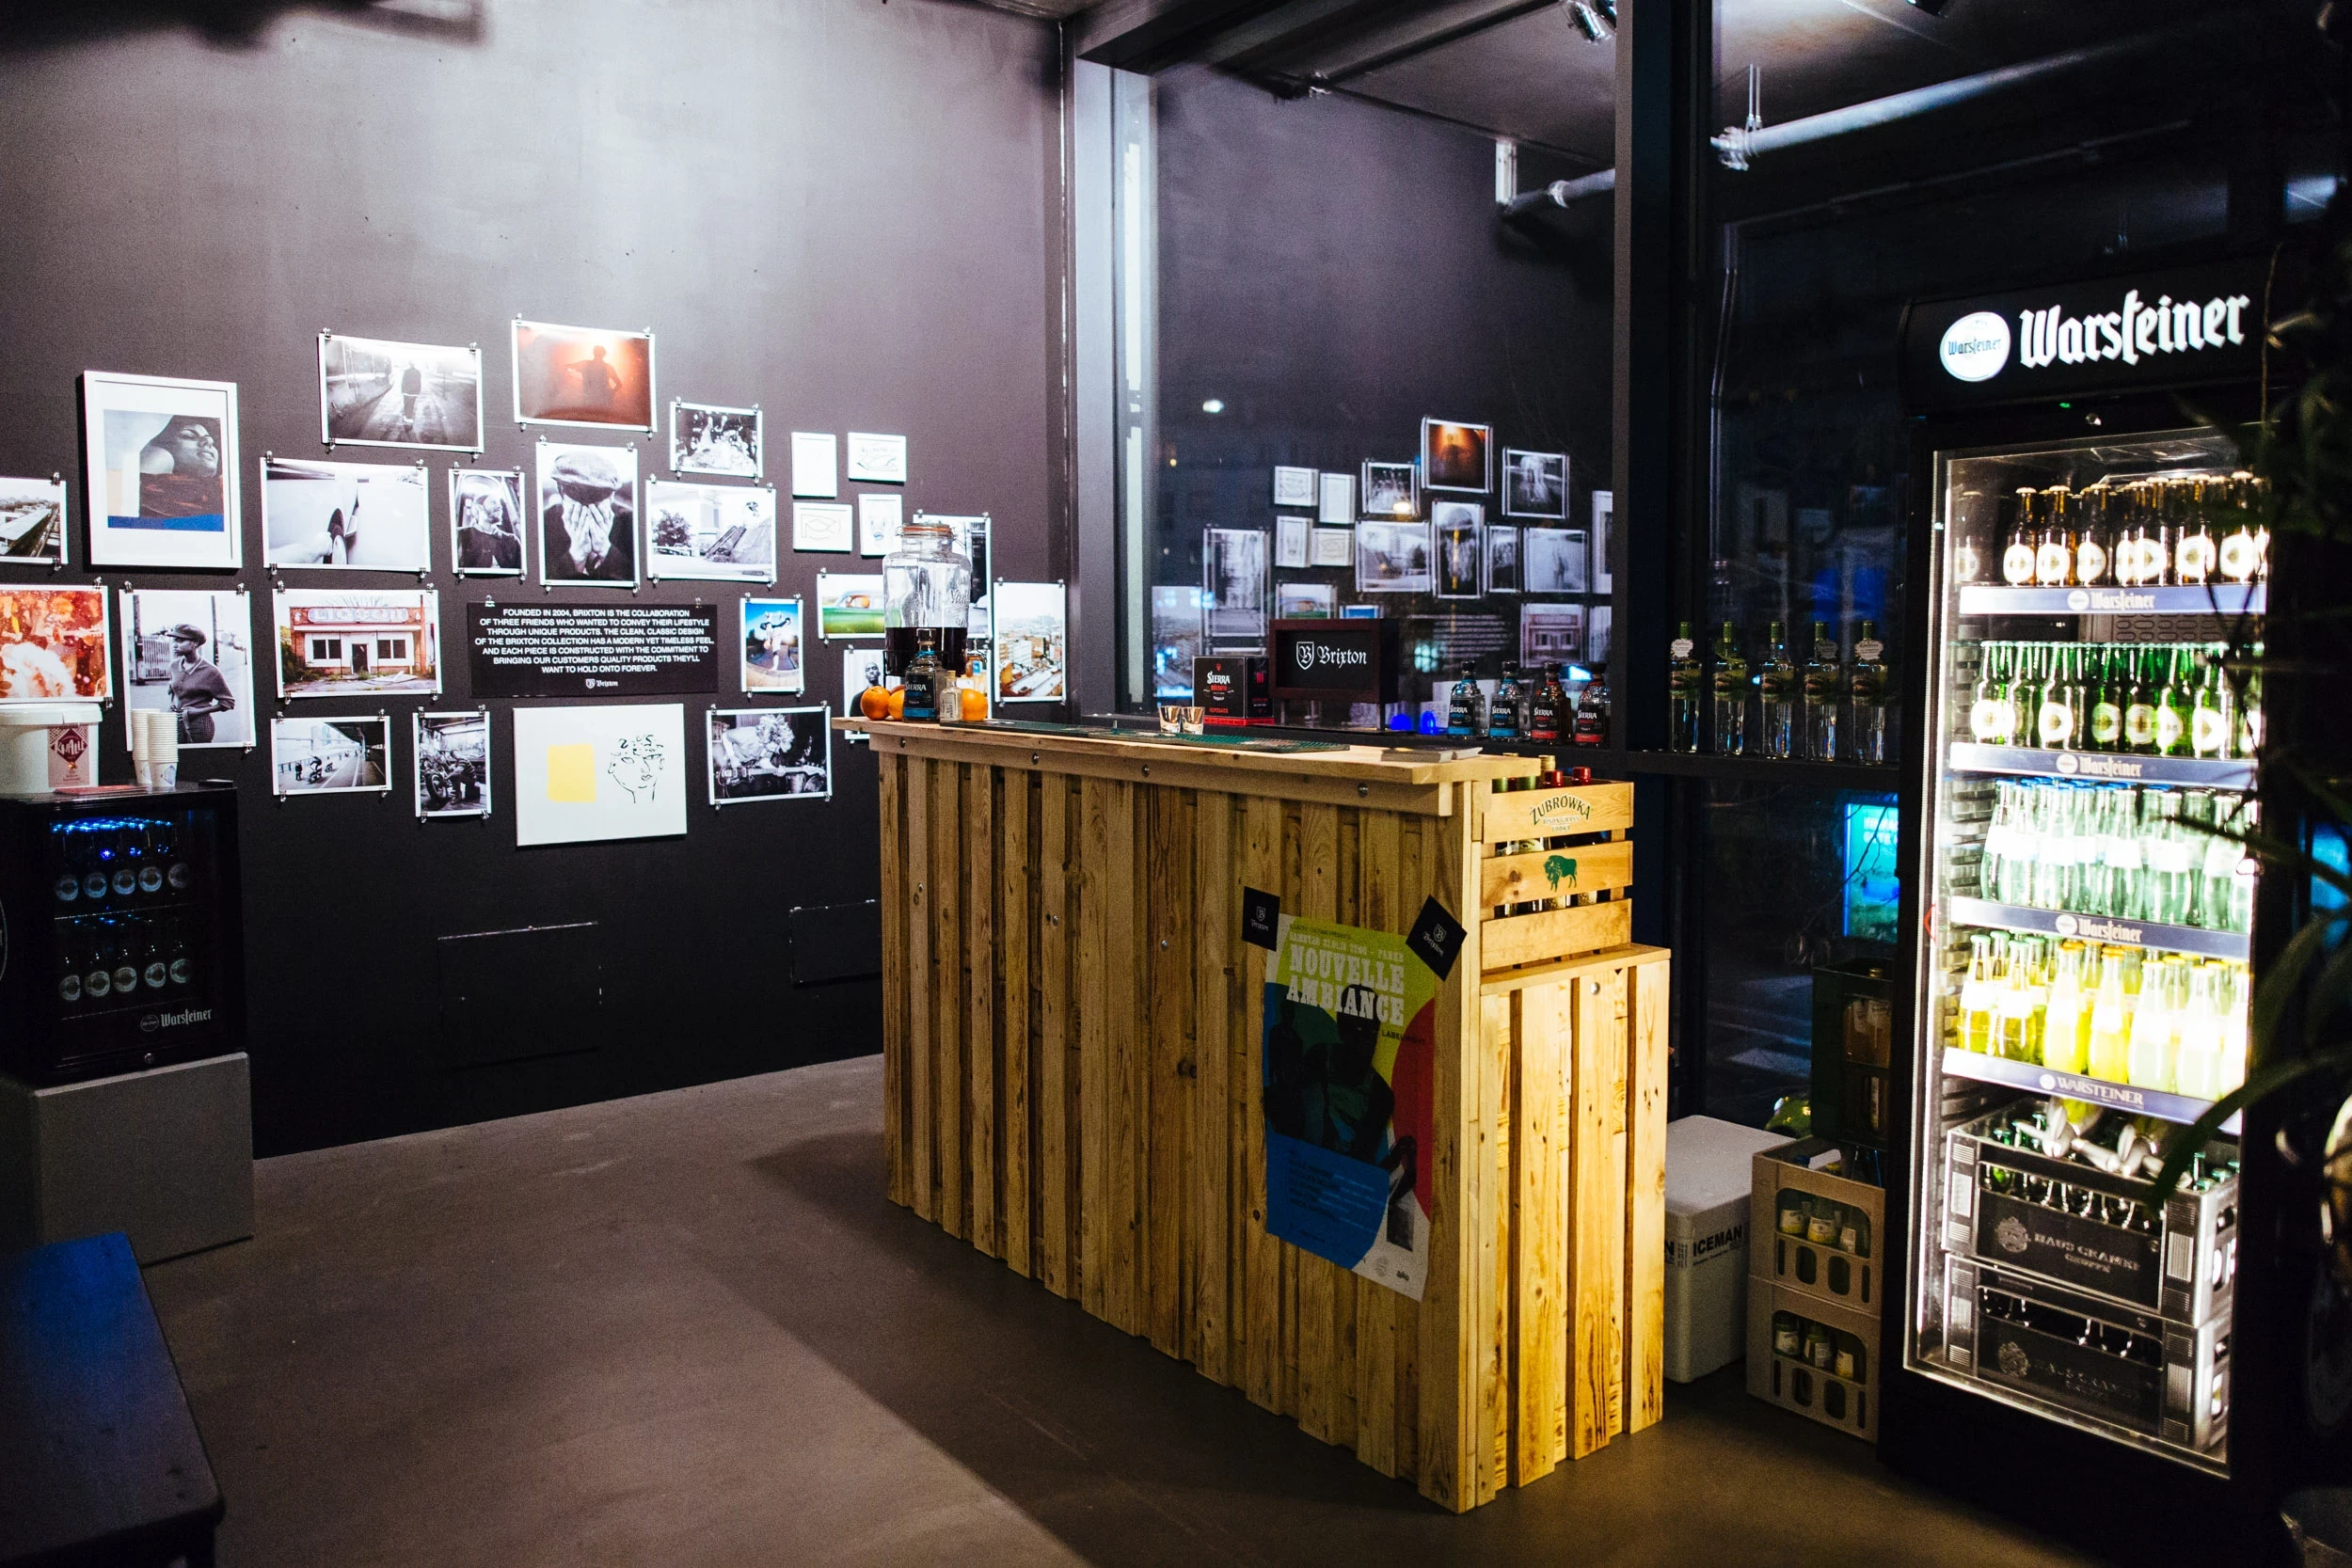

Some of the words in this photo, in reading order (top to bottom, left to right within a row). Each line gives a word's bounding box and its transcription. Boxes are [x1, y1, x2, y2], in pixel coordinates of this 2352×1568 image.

[2019, 289, 2250, 369] Warsteiner
[1948, 337, 2001, 356] Warsteiner
[2090, 590, 2155, 610] Warsteiner
[502, 609, 542, 617] FOUNDED
[543, 609, 551, 617] IN
[552, 609, 572, 617] 2004,
[572, 609, 606, 617] BRIXTON
[607, 609, 615, 617] IS
[615, 609, 630, 617] THE
[480, 618, 492, 626] OF
[492, 618, 520, 626] THREE
[520, 618, 555, 626] FRIENDS
[556, 618, 576, 626] WHO
[576, 618, 608, 626] WANTED
[609, 618, 619, 626] TO
[620, 618, 651, 626] CONVEY
[651, 618, 674, 626] THEIR
[486, 627, 527, 636] THROUGH
[528, 627, 558, 636] UNIQUE
[559, 627, 603, 636] PRODUCTS.
[604, 627, 619, 636] THE
[620, 627, 646, 636] CLEAN,
[646, 627, 677, 636] CLASSIC
[678, 627, 705, 636] DESIGN
[541, 637, 589, 645] COLLECTION
[590, 637, 606, 645] HAS
[606, 637, 612, 645] A
[612, 637, 644, 645] MODERN
[645, 637, 660, 645] YET
[660, 637, 694, 645] TIMELESS
[558, 646, 614, 655] CONSTRUCTED
[699, 645, 709, 654] TO
[551, 656, 599, 664] CUSTOMERS
[600, 656, 631, 664] QUALITY
[673, 655, 701, 663] THEY'LL
[1317, 645, 1367, 669] Brixton
[541, 665, 564, 673] WANT
[565, 665, 577, 673] TO
[577, 665, 598, 673] HOLD
[1207, 671, 1231, 685] SIERRA
[905, 681, 927, 692] SIERRA
[1450, 705, 1468, 714] SIERRA
[1492, 705, 1512, 715] SIERRA
[1534, 707, 1553, 717] SIERRA
[1578, 709, 1597, 720] SIERRA
[2079, 755, 2143, 778] Warsteiner
[2078, 917, 2143, 943] Warsteiner
[1290, 943, 1404, 995] NOUVELLE
[1286, 974, 1404, 1026] AMBIANCE
[161, 1008, 213, 1027] Warsteiner
[2057, 1076, 2144, 1105] WARSTEINER
[1692, 1225, 1743, 1258] ICEMAN
